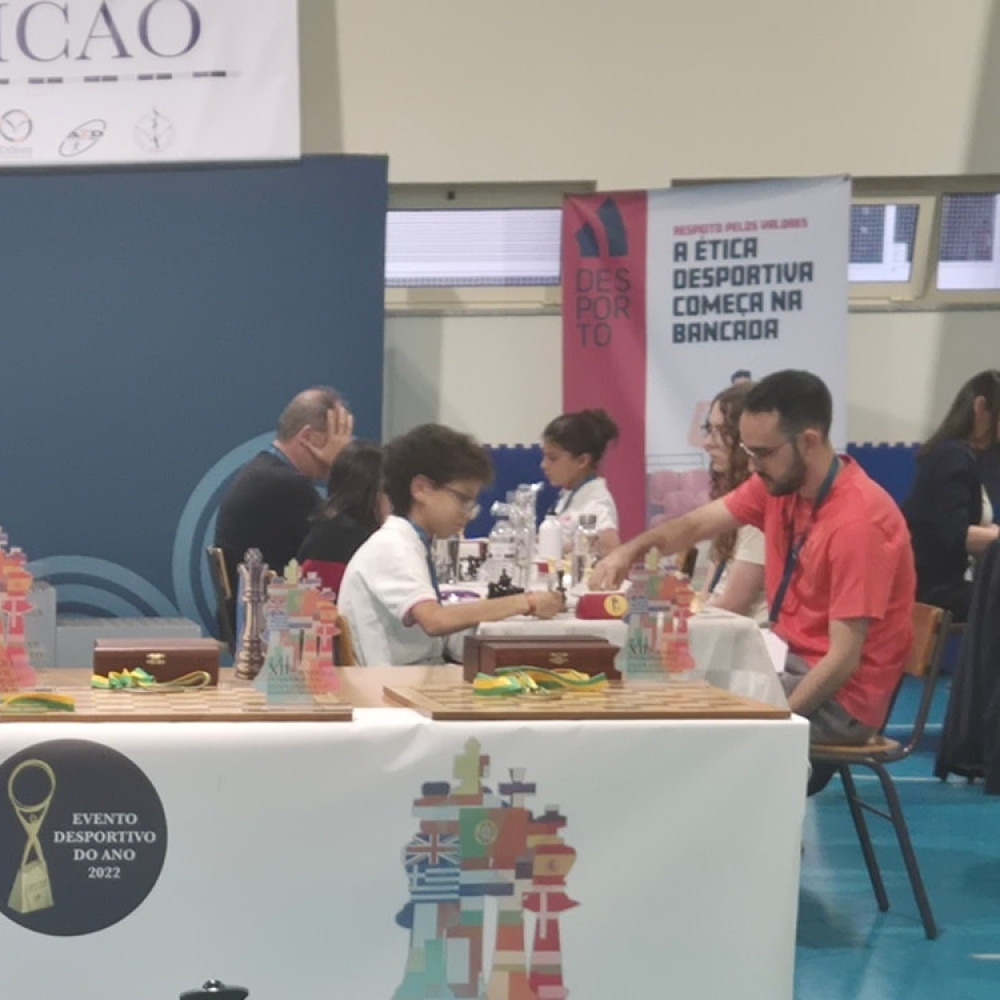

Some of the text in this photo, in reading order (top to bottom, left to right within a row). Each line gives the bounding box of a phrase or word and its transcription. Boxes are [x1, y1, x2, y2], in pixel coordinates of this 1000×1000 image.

[673, 223, 723, 236] RESPEITO
[761, 218, 808, 229] VALORES
[673, 234, 759, 262] A ÉTICA
[576, 267, 631, 294] DES
[672, 261, 814, 290] DESPORTIVA
[576, 295, 631, 321] POR
[672, 289, 803, 317] COMEÇA NA
[576, 323, 612, 348] TO
[671, 318, 780, 345] BANCADA
[72, 812, 138, 825] EVENTO
[53, 830, 157, 844] DESPORTIVO
[73, 848, 137, 861] DO ANO
[87, 866, 121, 879] 2022
